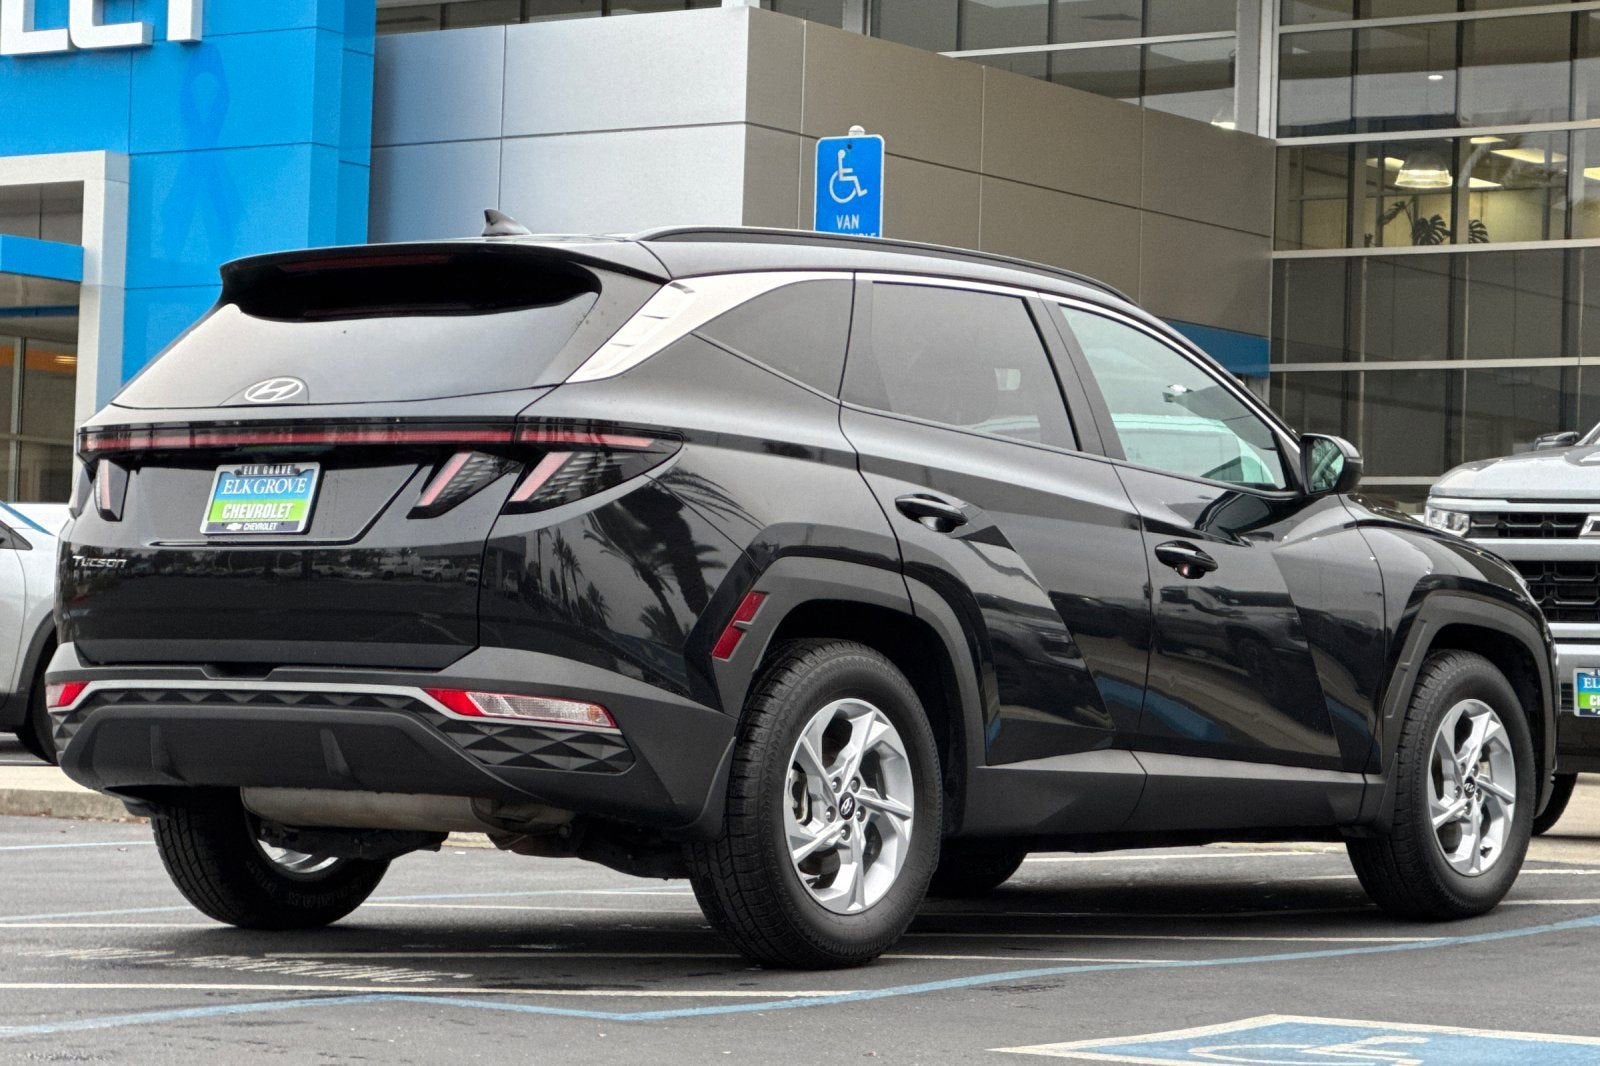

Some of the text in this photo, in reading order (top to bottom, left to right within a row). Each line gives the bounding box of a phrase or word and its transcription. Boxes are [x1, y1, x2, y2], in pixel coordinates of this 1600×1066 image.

[836, 214, 860, 229] VAN
[243, 464, 292, 475] ELK GROVE
[221, 478, 308, 495] ELK GROVE
[221, 502, 294, 519] CHEVROLET
[243, 522, 278, 531] CHEVROLET
